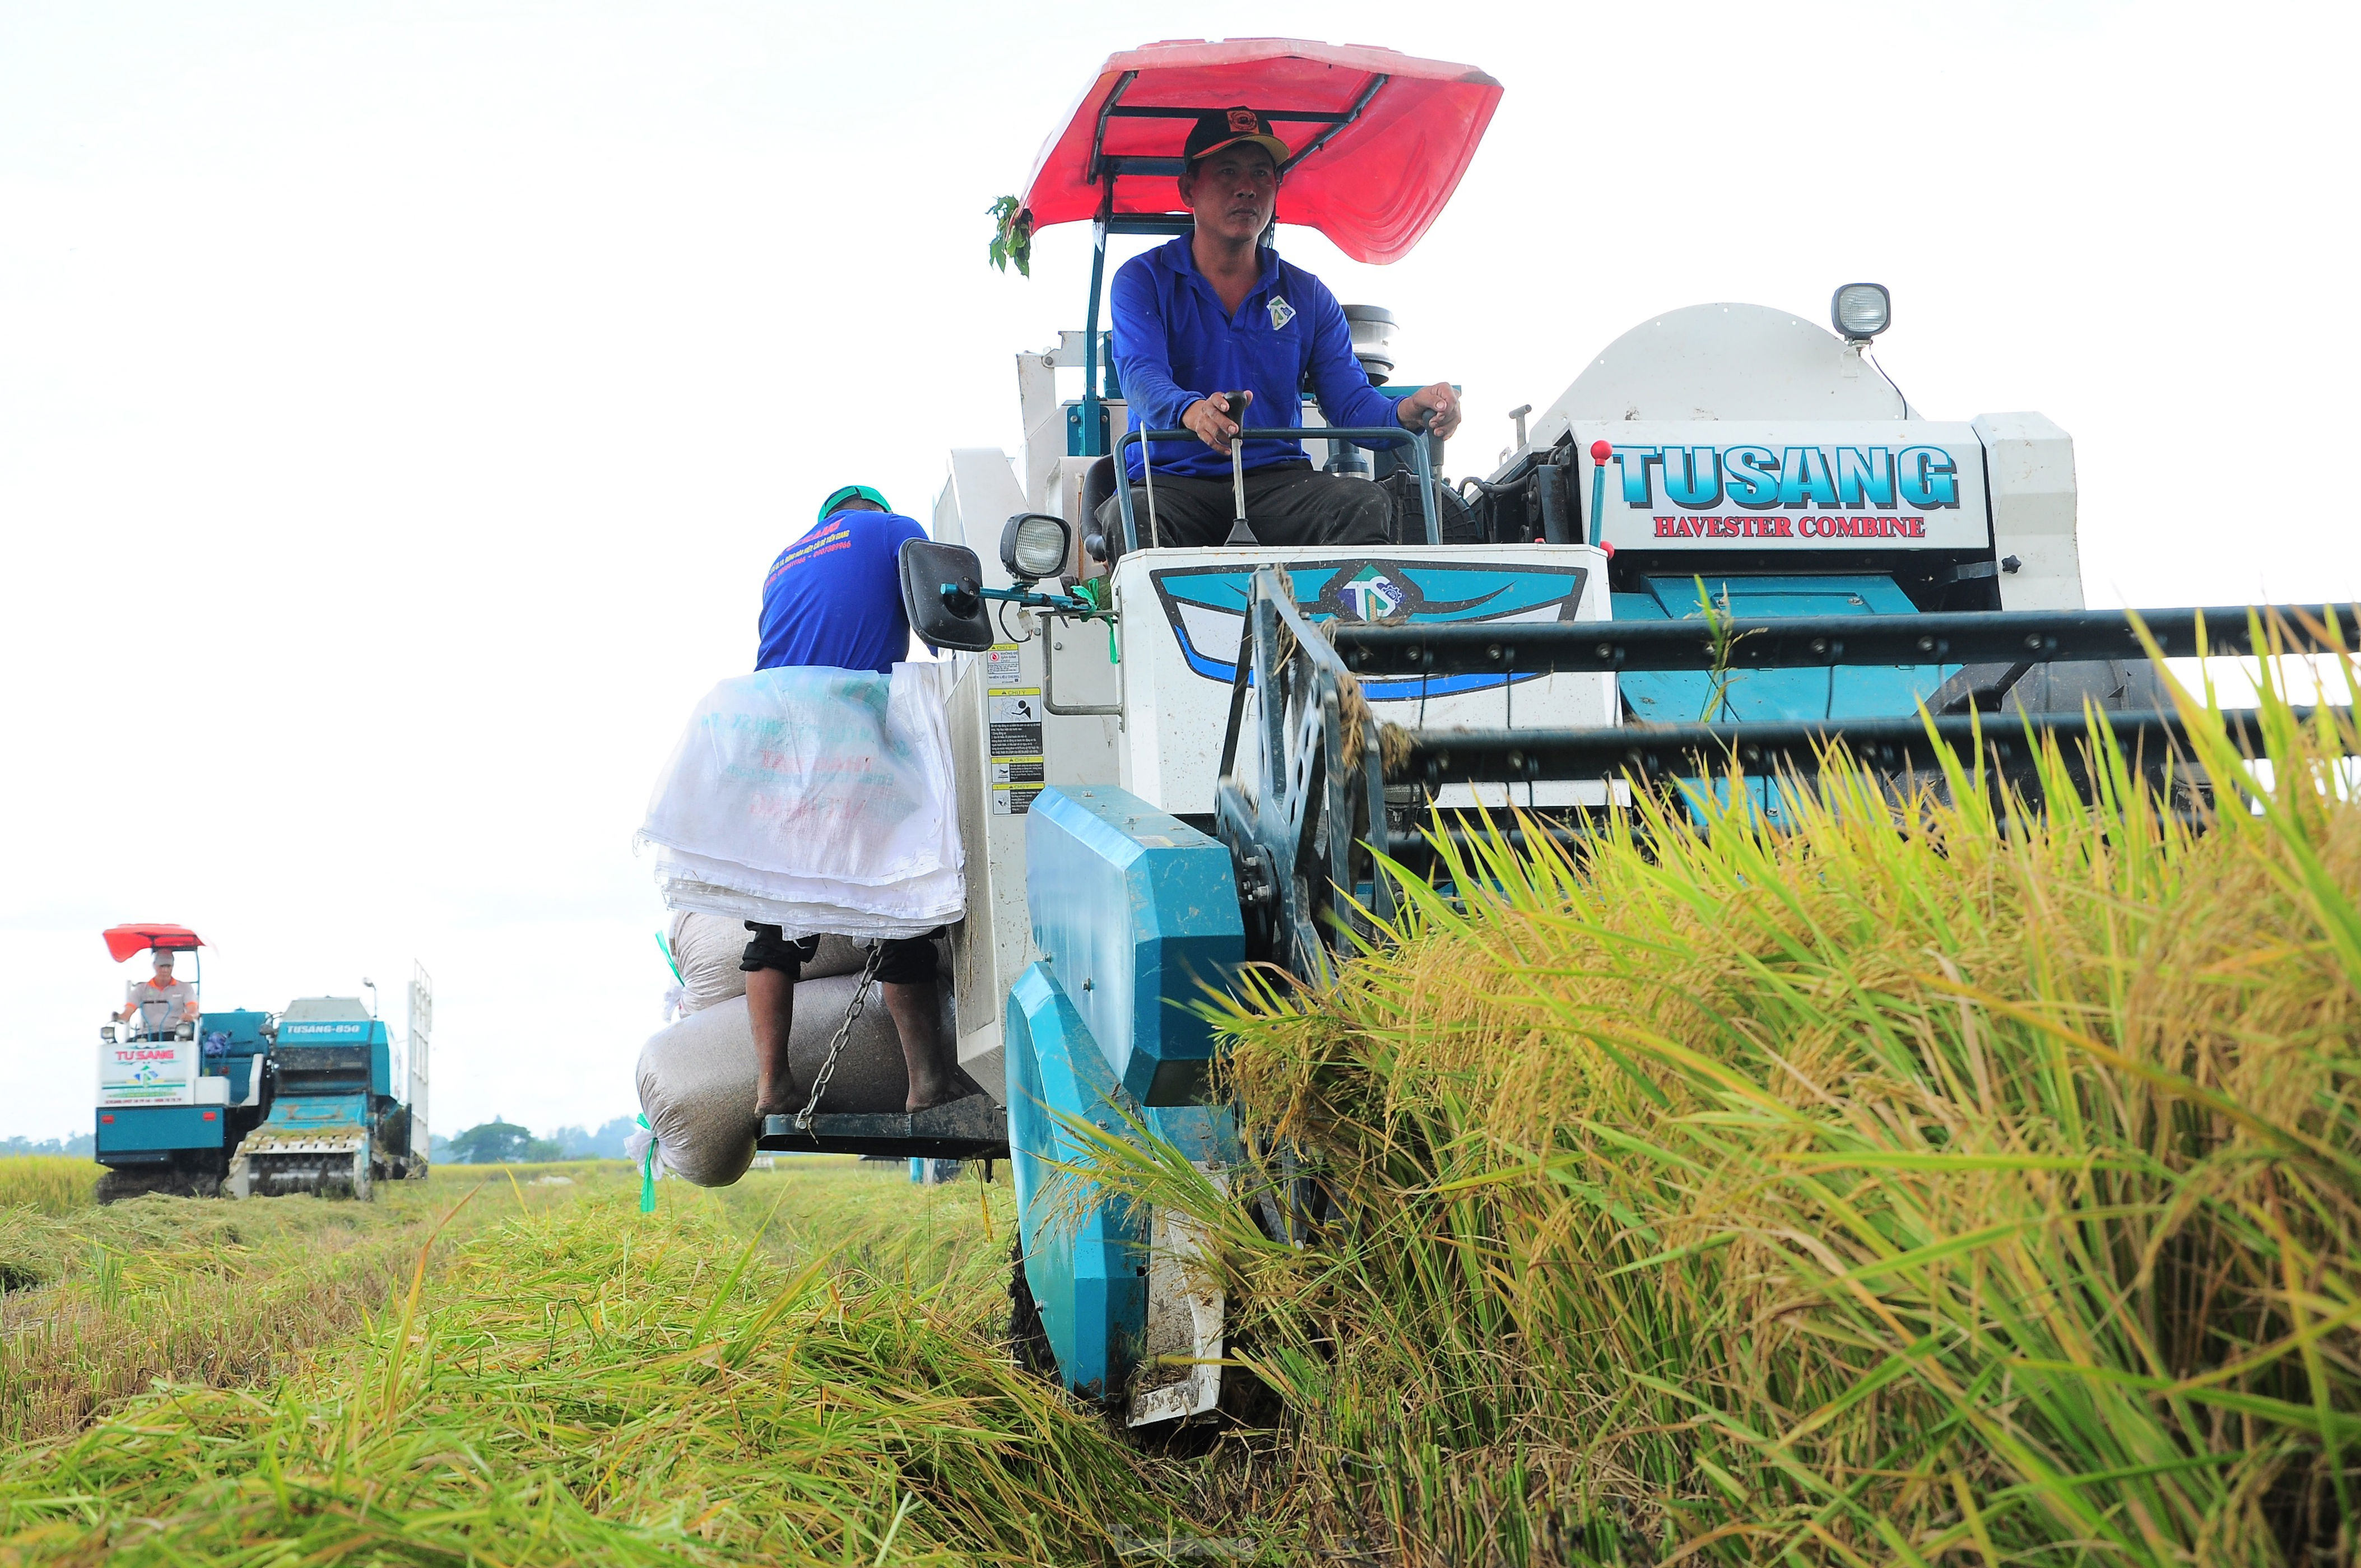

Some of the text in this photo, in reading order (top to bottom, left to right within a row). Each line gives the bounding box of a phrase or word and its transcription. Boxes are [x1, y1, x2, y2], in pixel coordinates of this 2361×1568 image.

[1611, 445, 1958, 510] TUSANG
[1653, 516, 1926, 538] HAVESTER COMBINE
[286, 1024, 361, 1034] TUSANG-850
